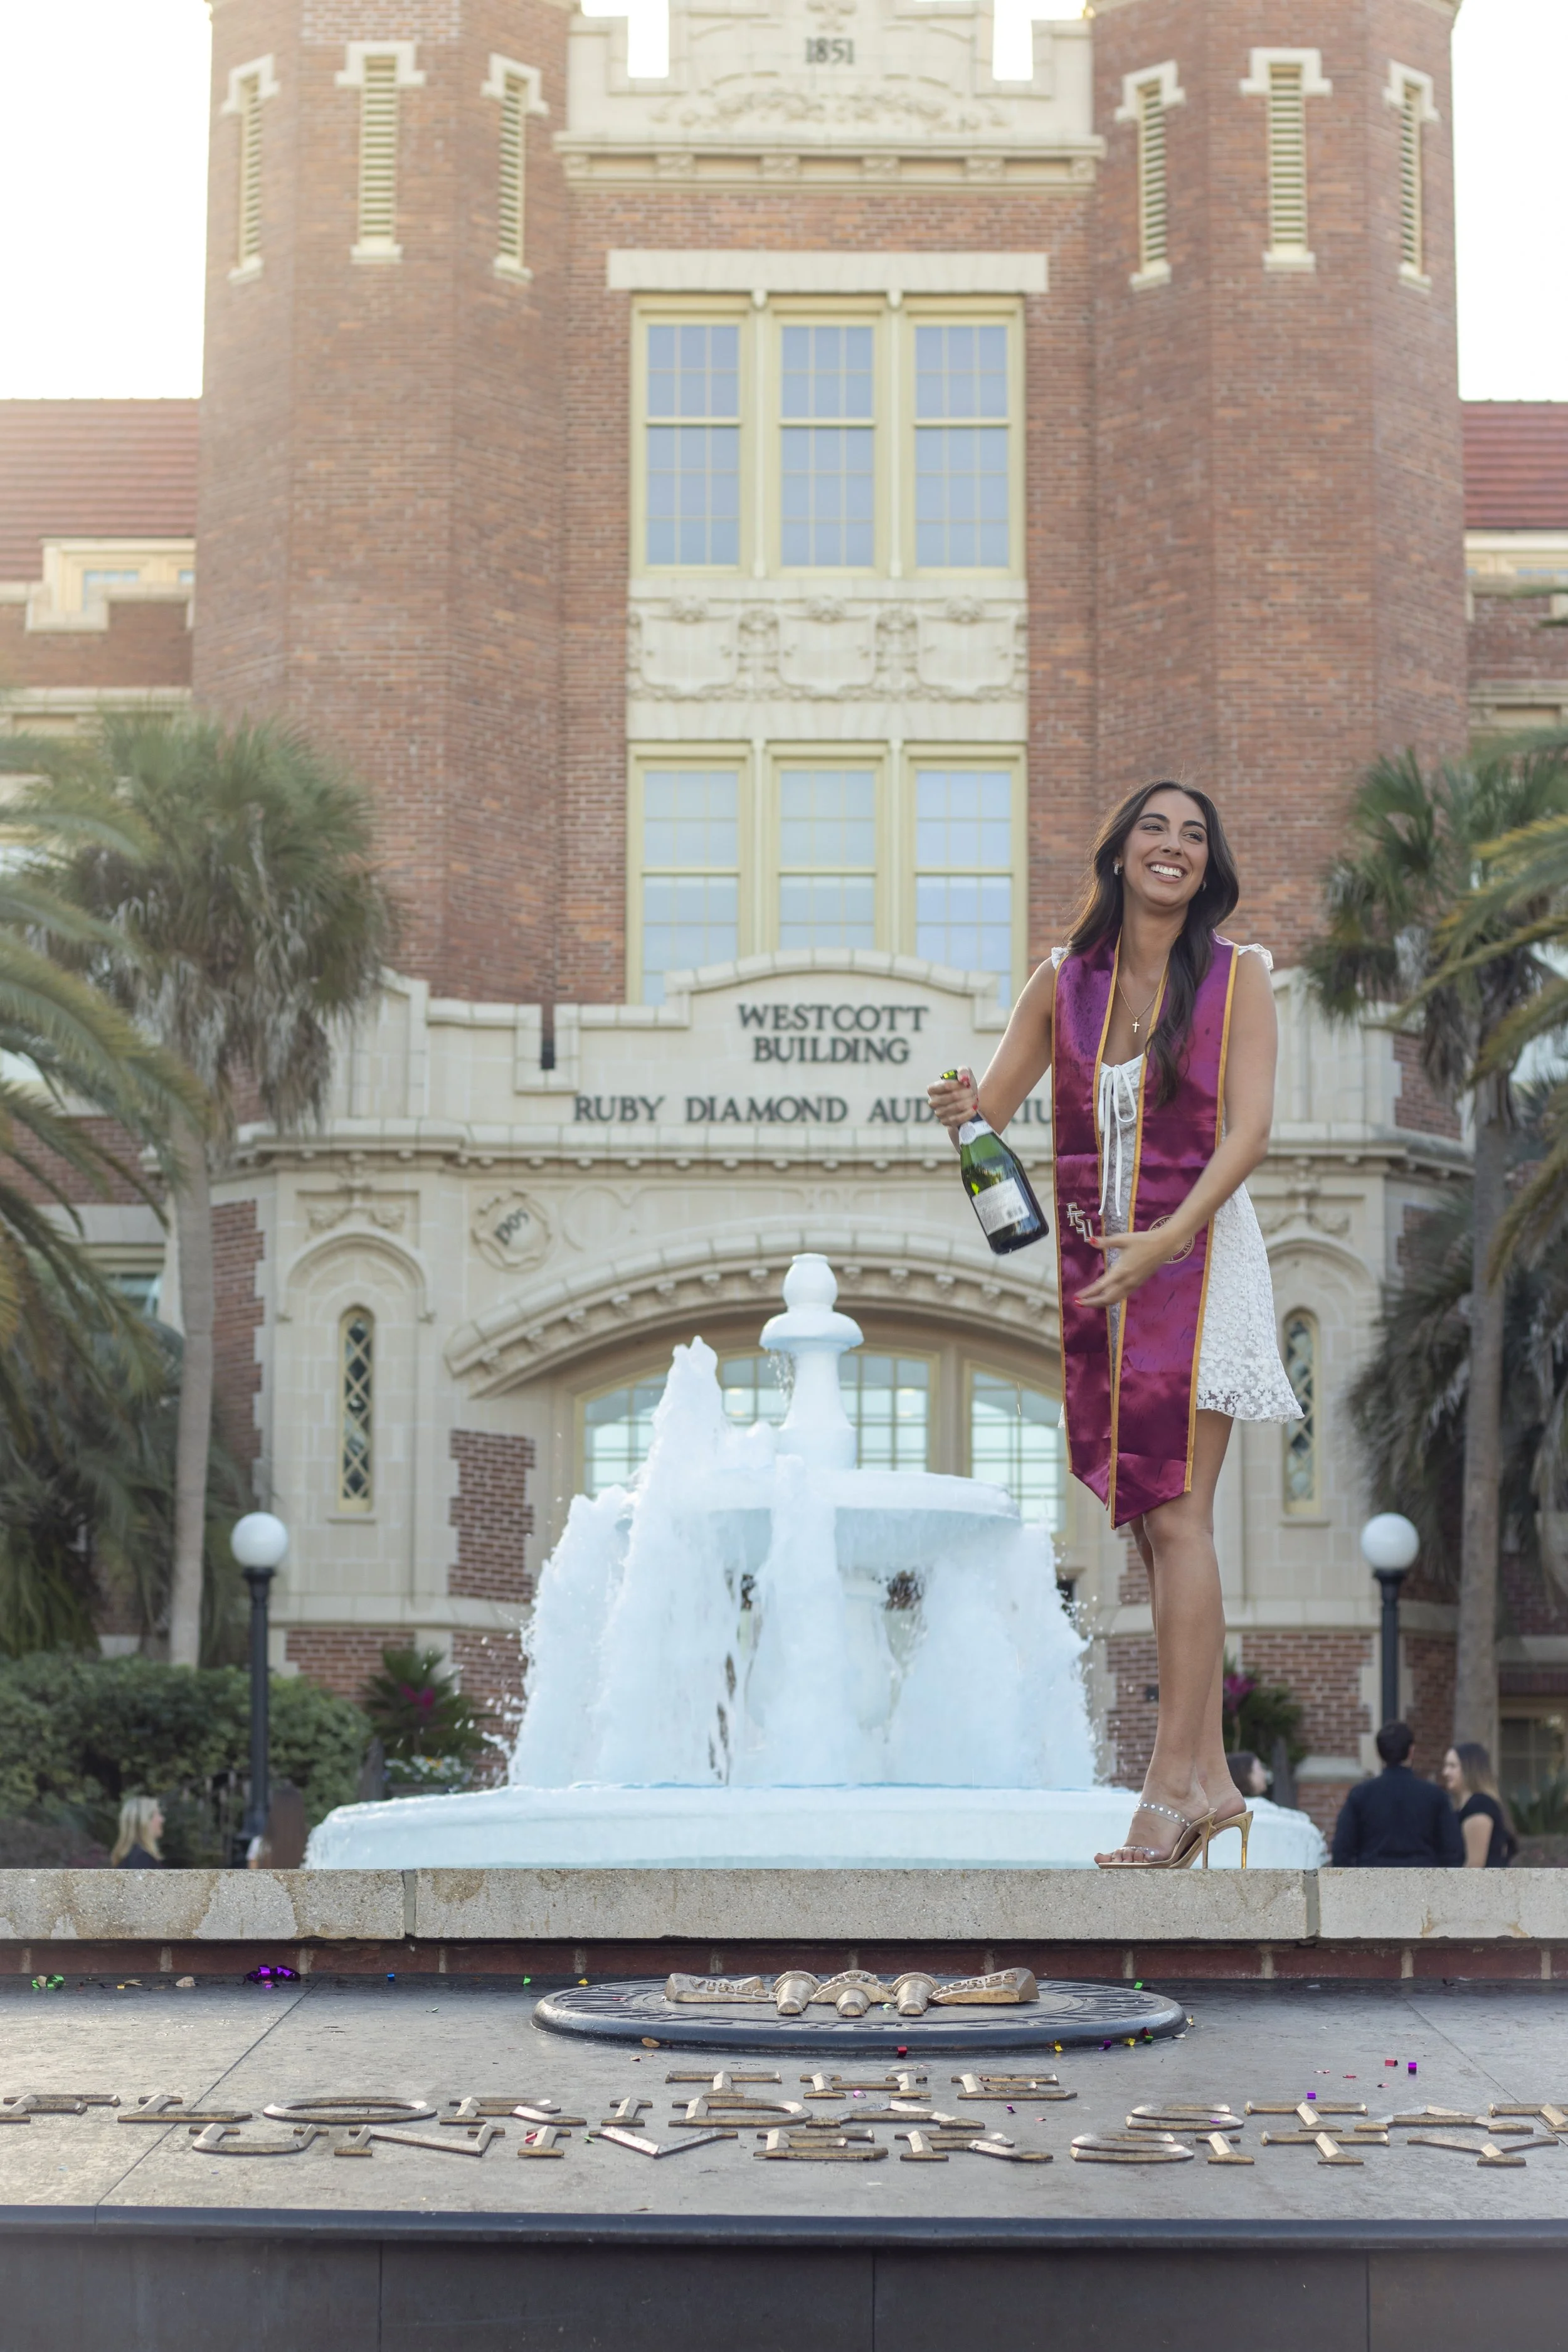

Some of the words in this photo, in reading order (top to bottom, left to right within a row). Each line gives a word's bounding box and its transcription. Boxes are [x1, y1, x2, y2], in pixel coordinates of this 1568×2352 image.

[805, 37, 854, 65] 1851
[738, 1004, 929, 1032] WESTCOTT
[753, 1036, 910, 1064] BUILDING
[573, 1096, 665, 1123] RUBY
[686, 1096, 849, 1123] DIAMOND
[868, 1096, 1052, 1124] AUDIU
[1066, 1202, 1094, 1243] FSU
[664, 2070, 1079, 2100] THE
[0, 2093, 985, 2131] FLORIDA
[1125, 2102, 1568, 2134] STAT
[188, 2122, 1559, 2167] UNIVERSITY
